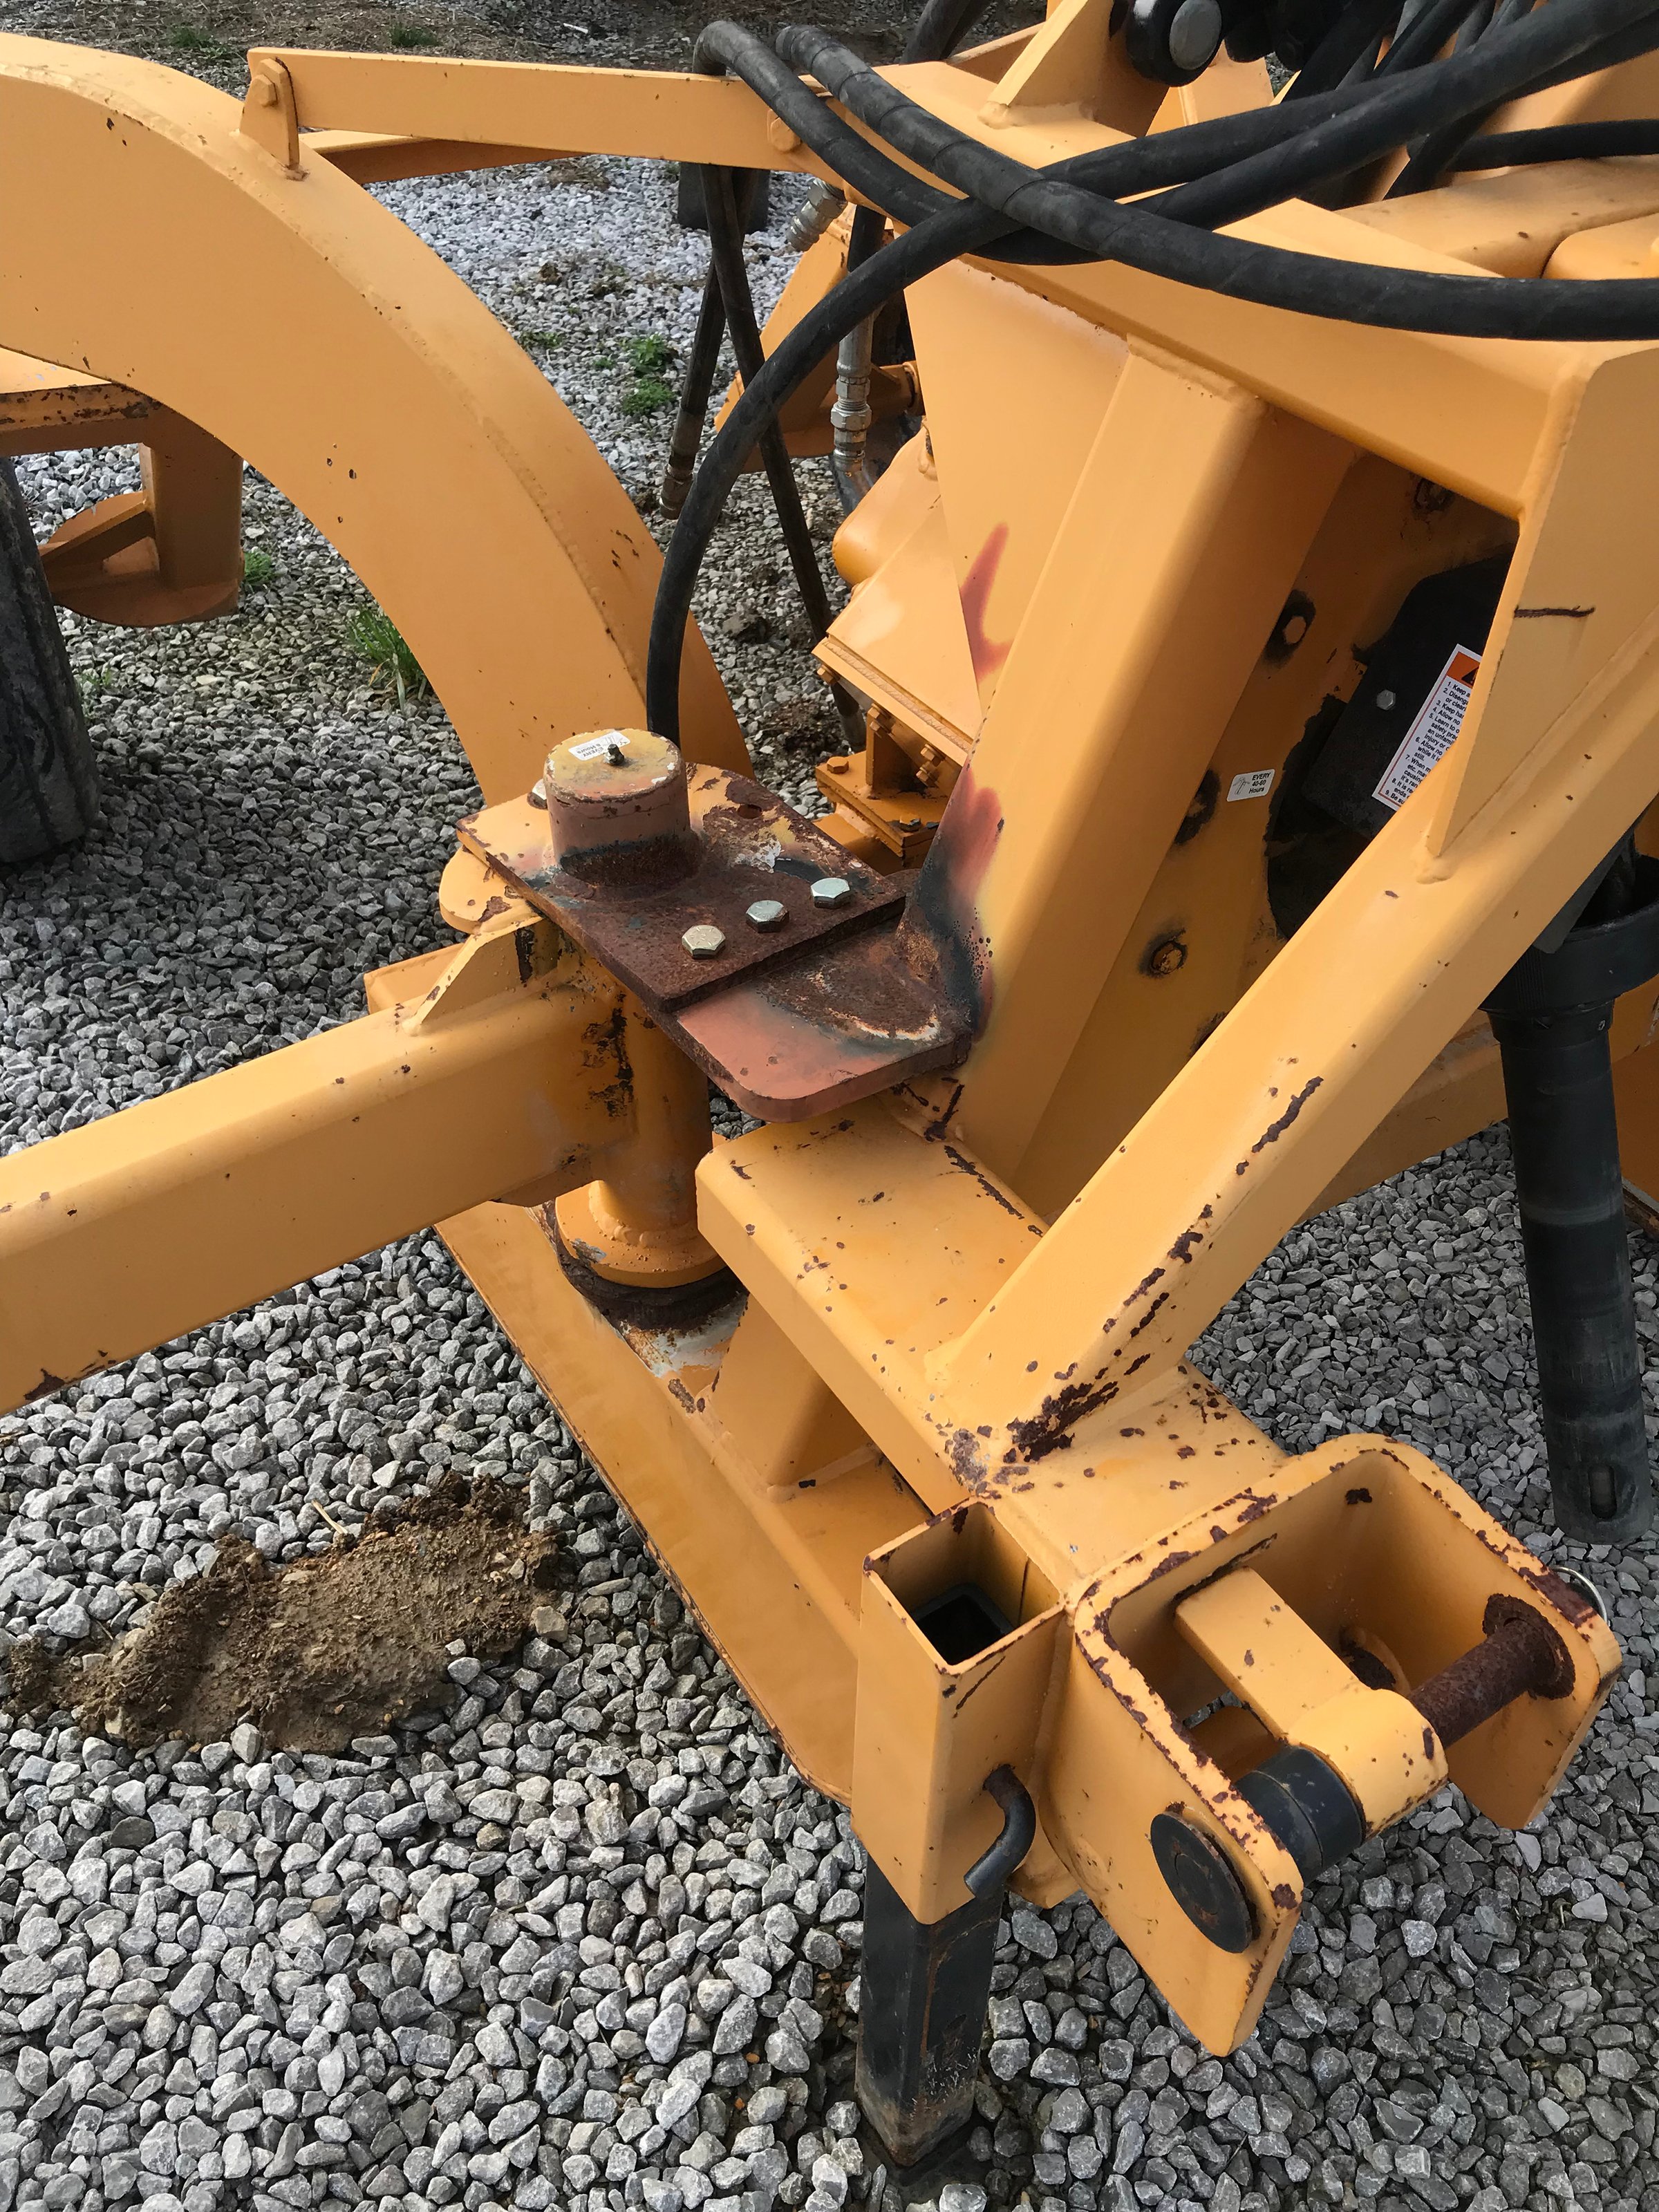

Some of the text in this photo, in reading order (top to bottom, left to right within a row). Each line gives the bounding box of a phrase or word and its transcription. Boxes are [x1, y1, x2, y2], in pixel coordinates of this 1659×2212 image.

[1452, 684, 1466, 695] Keep
[1442, 703, 1455, 714] Keep
[1438, 710, 1453, 721] Allow
[1434, 716, 1449, 727] Learn
[1431, 722, 1447, 734] safety
[1421, 740, 1435, 751] Allow
[1424, 734, 1439, 746] injury
[1414, 752, 1424, 761] still.
[1418, 747, 1431, 756] while
[1411, 758, 1425, 768] When
[1252, 772, 1271, 780] EVERY
[1394, 788, 1407, 797] ends
